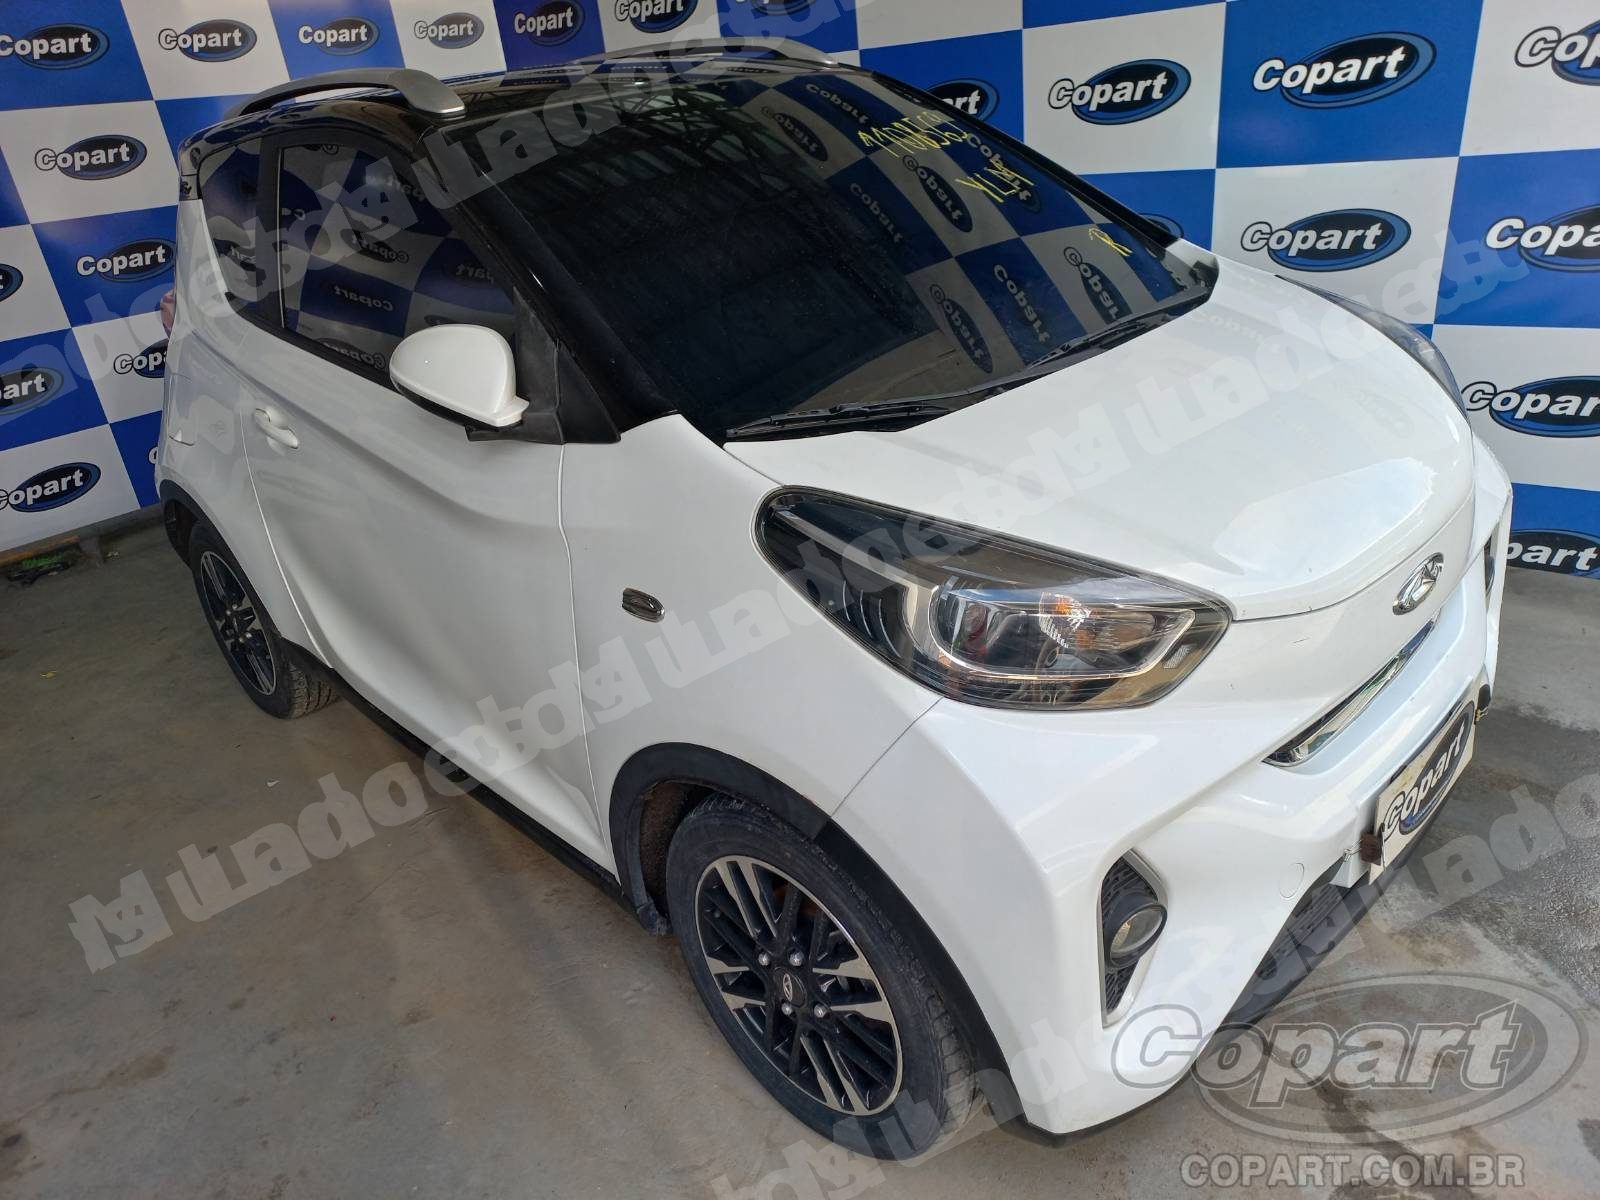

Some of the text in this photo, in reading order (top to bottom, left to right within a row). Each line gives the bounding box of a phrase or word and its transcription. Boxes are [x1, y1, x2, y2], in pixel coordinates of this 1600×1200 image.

[414, 19, 474, 42] Copart
[514, 7, 573, 35] Copart
[158, 27, 242, 52] Copart
[299, 24, 368, 48] Copart
[1253, 43, 1406, 96] Copart
[1049, 70, 1167, 111] Copart
[35, 143, 130, 171] Copart
[1241, 219, 1382, 255] Copart
[76, 245, 166, 277] Copart
[113, 353, 167, 374] Cop
[0, 374, 46, 400] art
[1384, 721, 1465, 842] Copart
